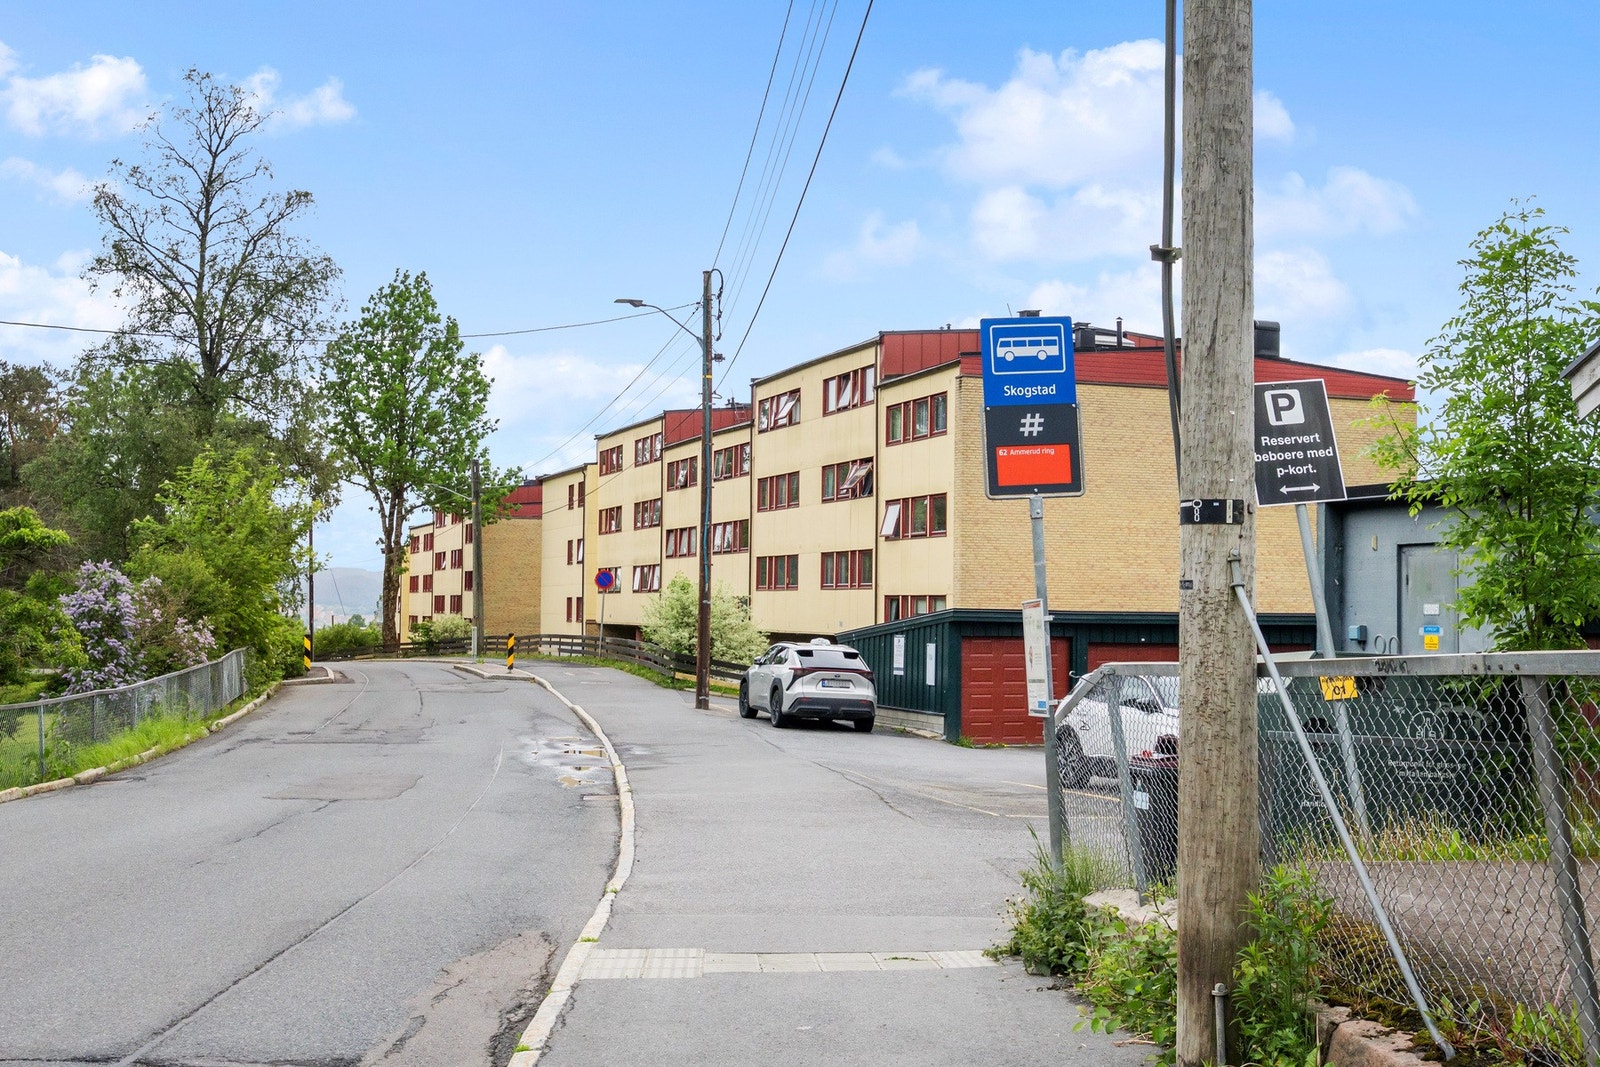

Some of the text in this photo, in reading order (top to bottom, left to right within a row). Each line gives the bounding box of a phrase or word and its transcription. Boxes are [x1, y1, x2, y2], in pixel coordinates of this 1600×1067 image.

[1004, 384, 1056, 398] Skogstad
[1271, 392, 1296, 422] P
[1260, 432, 1321, 447] Reservert
[1009, 448, 1041, 456] Ammerud
[1042, 447, 1055, 455] ring
[1254, 446, 1334, 463] beboere med
[1276, 463, 1317, 478] p-kort.
